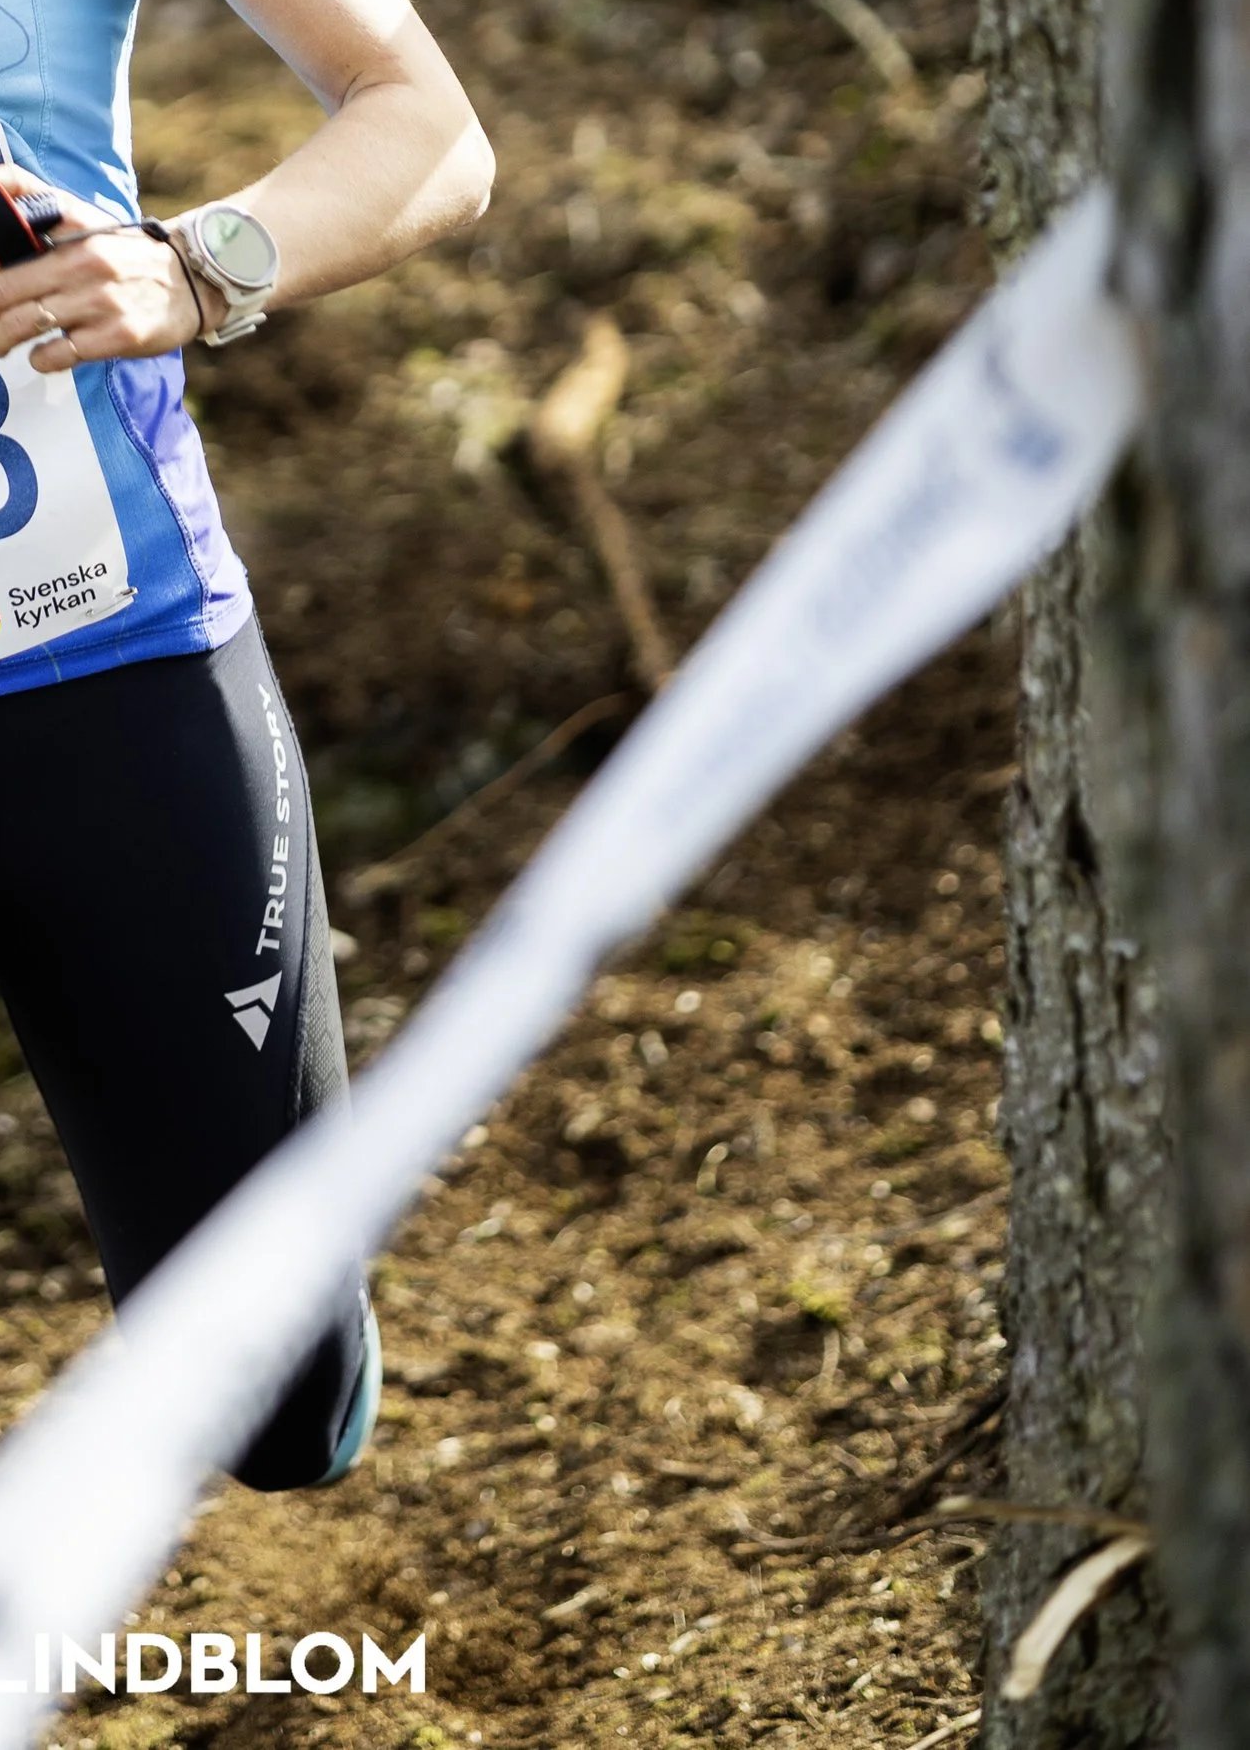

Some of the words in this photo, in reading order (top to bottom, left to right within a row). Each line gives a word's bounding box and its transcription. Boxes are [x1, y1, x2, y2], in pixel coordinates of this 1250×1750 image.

[8, 559, 108, 607] Svenska
[14, 586, 97, 629] kyrkan
[258, 683, 291, 824] STORY
[255, 834, 291, 956] TRUE
